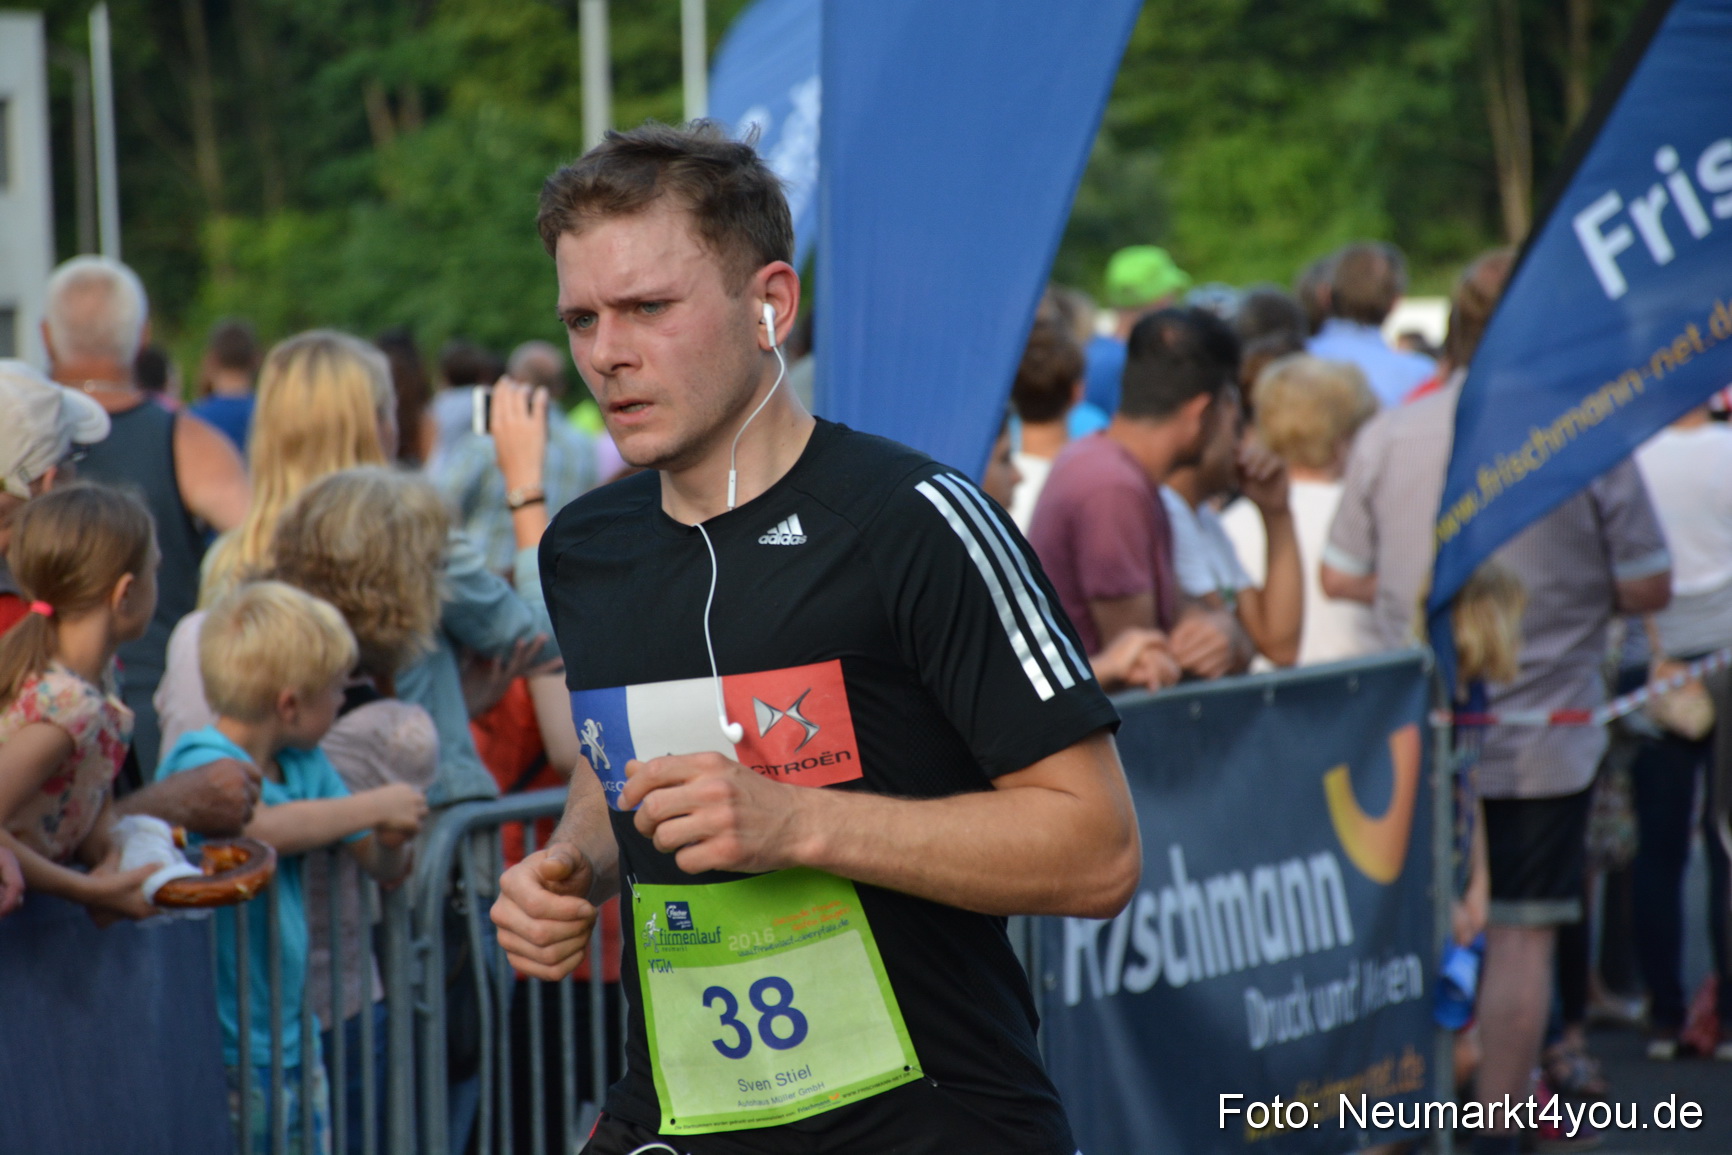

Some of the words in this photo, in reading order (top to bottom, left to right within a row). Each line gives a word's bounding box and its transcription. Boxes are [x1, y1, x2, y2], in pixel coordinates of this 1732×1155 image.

[758, 532, 807, 545] adidas
[659, 926, 722, 946] firmenlauf
[728, 928, 775, 951] 2016
[702, 976, 808, 1060] 38
[738, 1078, 772, 1092] Sven
[775, 1064, 812, 1087] Stiel
[798, 1081, 825, 1096] GmbH
